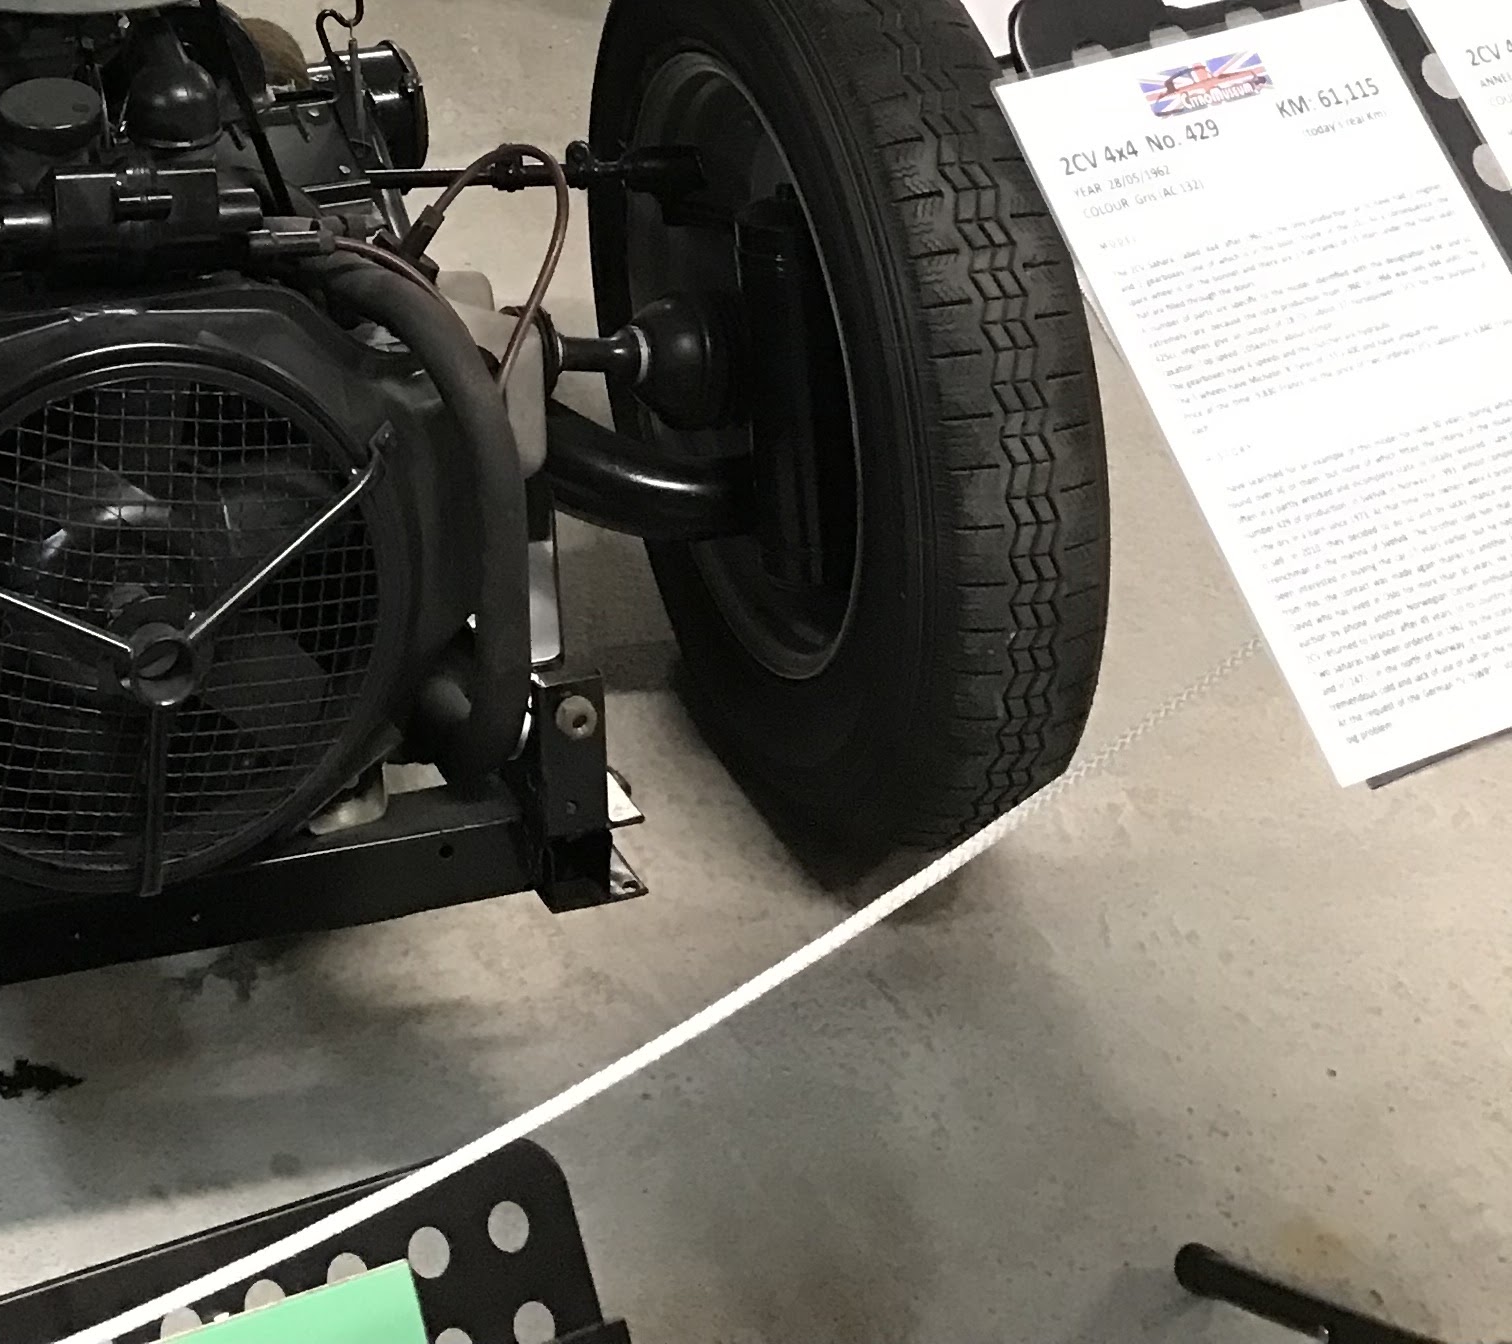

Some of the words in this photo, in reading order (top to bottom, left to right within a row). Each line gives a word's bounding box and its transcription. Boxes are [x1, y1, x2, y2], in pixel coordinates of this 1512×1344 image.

[1466, 43, 1500, 66] 2CV
[1275, 95, 1317, 118] KM:
[1317, 77, 1379, 108] 61,115
[1059, 150, 1098, 175] 2CV
[1104, 140, 1138, 162] 4x4
[1145, 133, 1182, 153] No.
[1185, 119, 1219, 141] 429
[1073, 182, 1103, 198] YEAR
[1109, 164, 1171, 190] 28/05/1962
[1082, 197, 1131, 219] COLOUR
[1134, 192, 1158, 205] Gris
